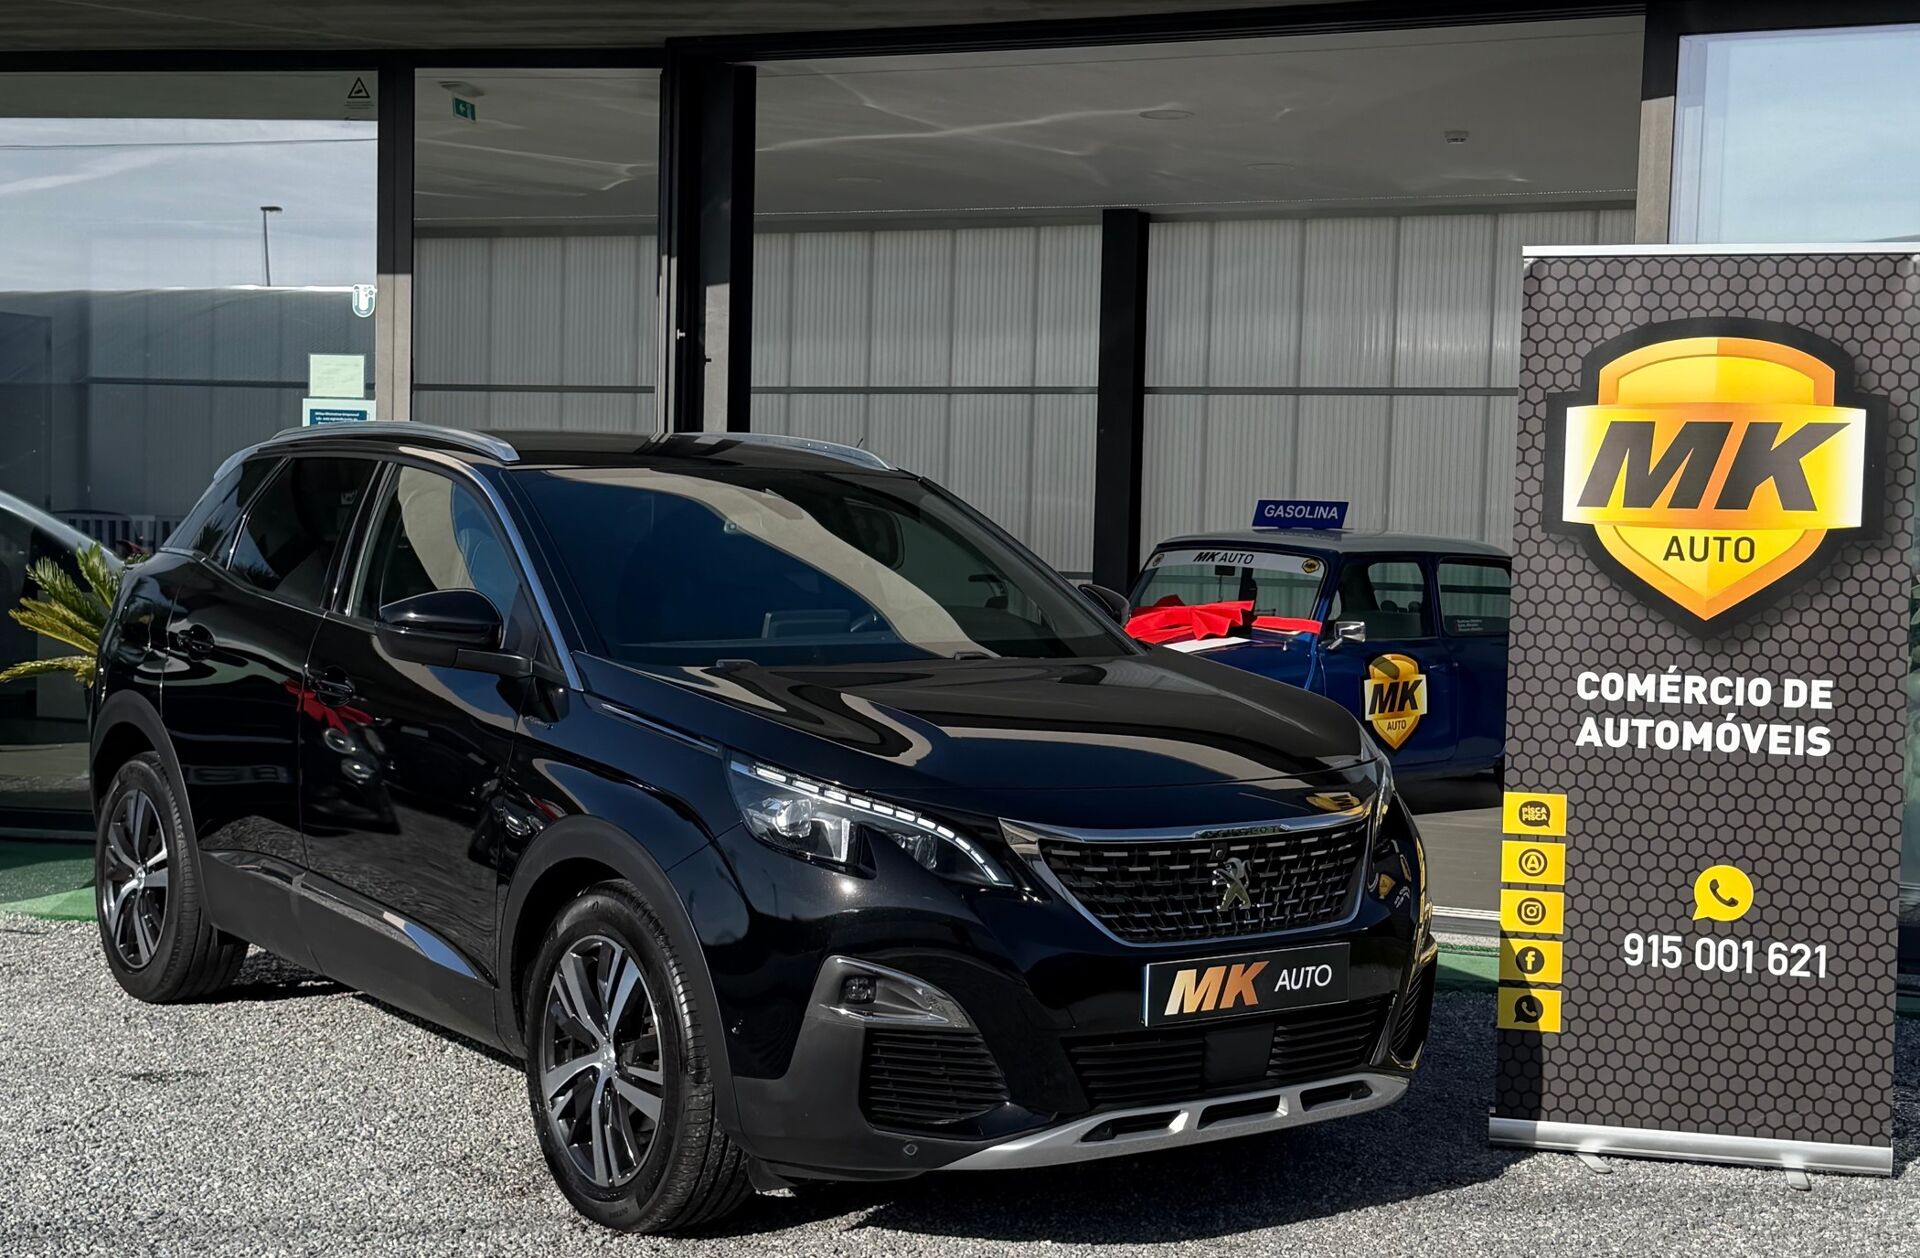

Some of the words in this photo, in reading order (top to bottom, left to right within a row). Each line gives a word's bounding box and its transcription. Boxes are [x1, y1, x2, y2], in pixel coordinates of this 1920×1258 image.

[1577, 421, 1851, 511] MK
[1264, 504, 1338, 519] GASOLINA
[1193, 551, 1221, 562] MK
[1219, 553, 1255, 564] AUTO
[1663, 535, 1756, 563] AUTO
[1368, 679, 1423, 715] MK
[1576, 665, 1772, 707] COMÉRCIO
[1783, 678, 1833, 709] DE
[1387, 720, 1406, 731] AUTO
[1576, 713, 1832, 756] AUTOMÓVEIS
[1623, 933, 1682, 968] 915
[1694, 937, 1755, 974] 001
[1767, 942, 1827, 979] 621
[1163, 960, 1270, 1016] MK
[1274, 964, 1332, 992] AUTO
